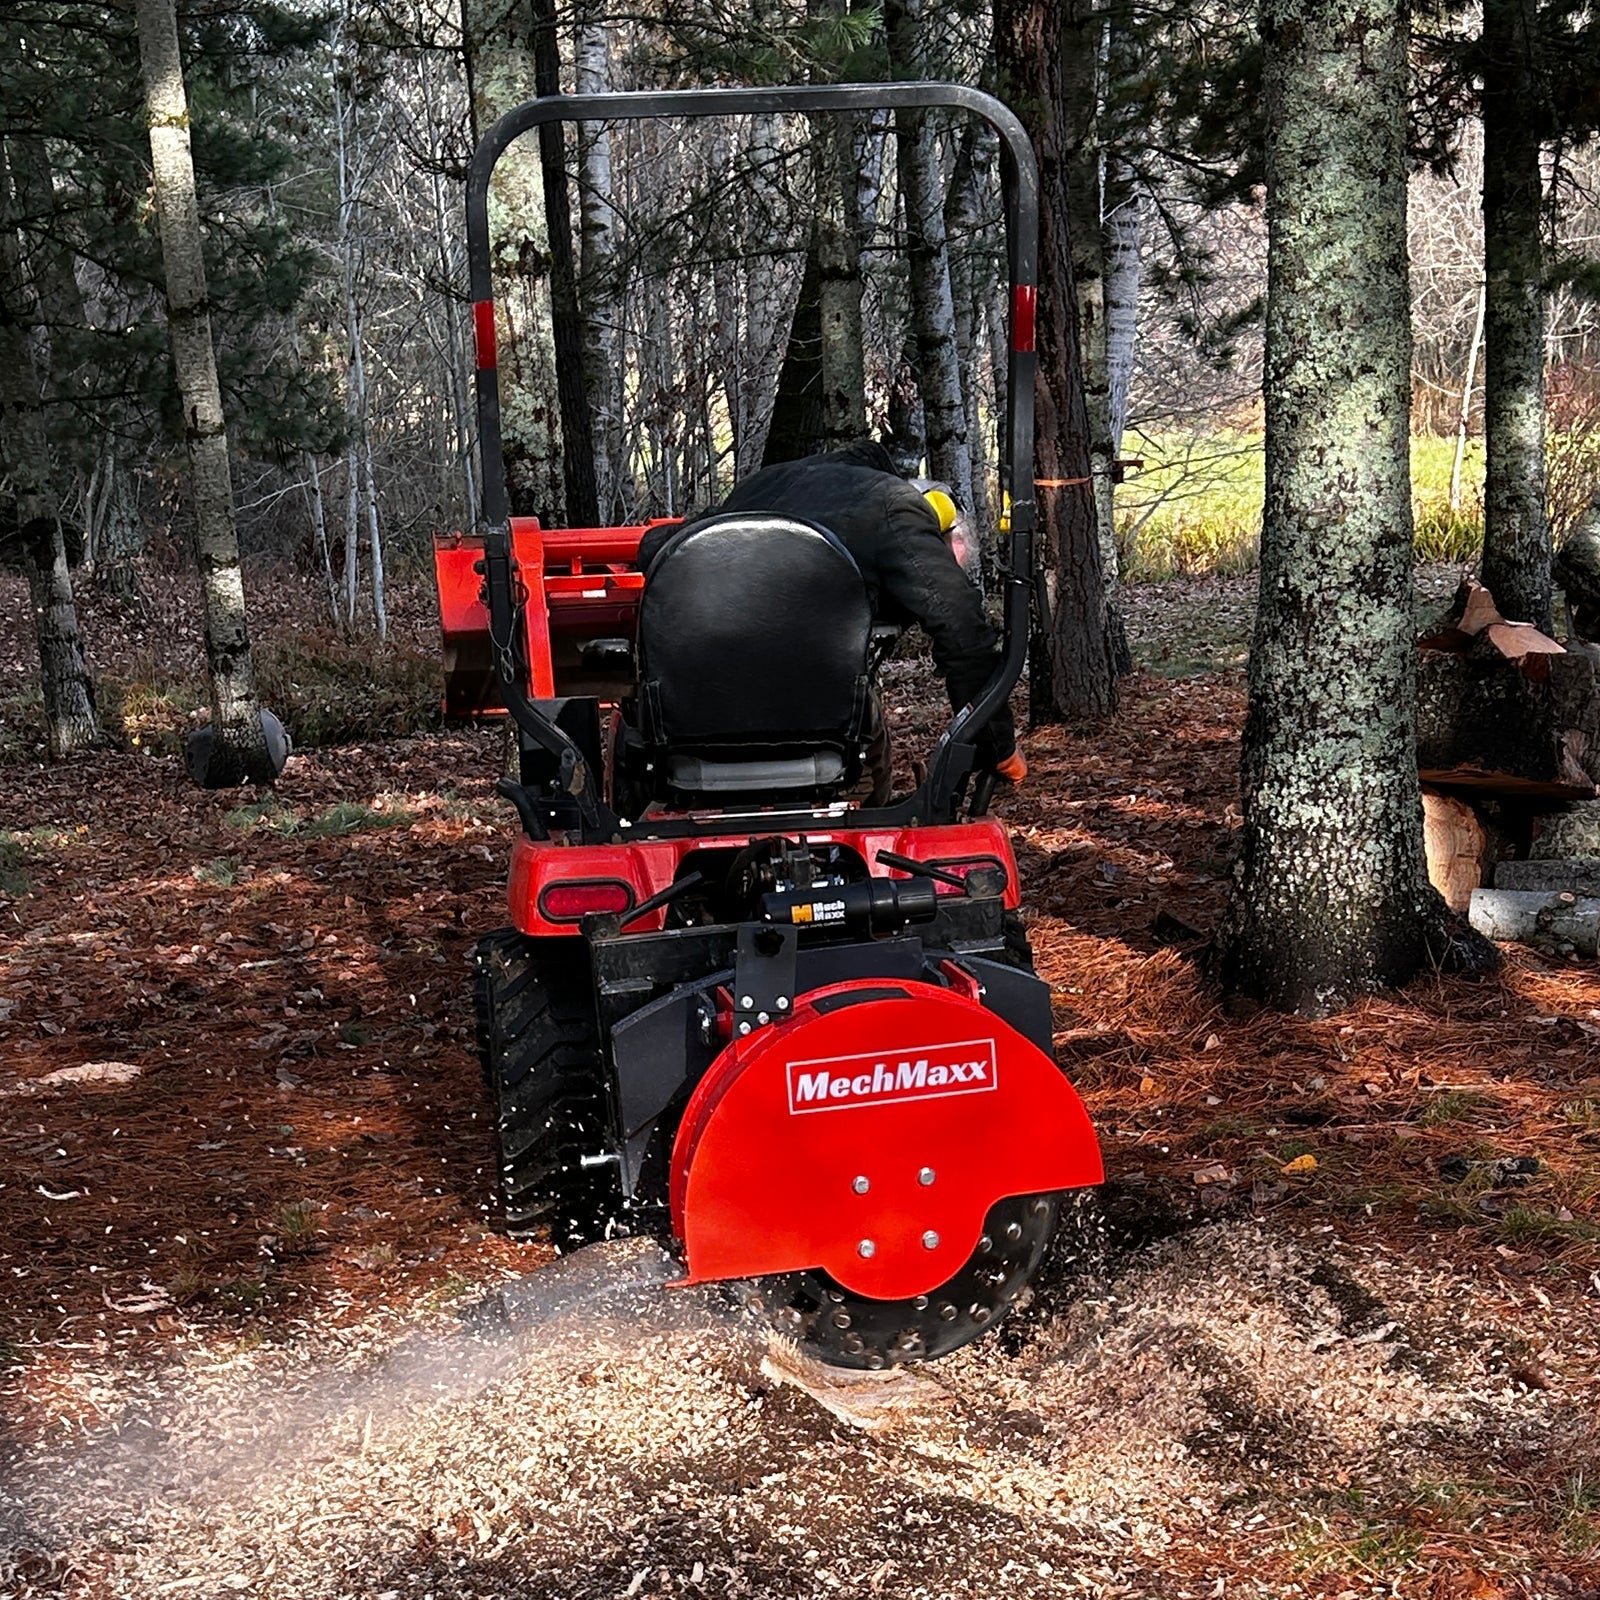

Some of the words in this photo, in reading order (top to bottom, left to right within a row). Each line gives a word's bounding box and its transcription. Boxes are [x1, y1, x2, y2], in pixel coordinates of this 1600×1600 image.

[812, 900, 845, 912] Mech
[813, 910, 845, 921] Maxx
[796, 1060, 988, 1103] MechMaxx
